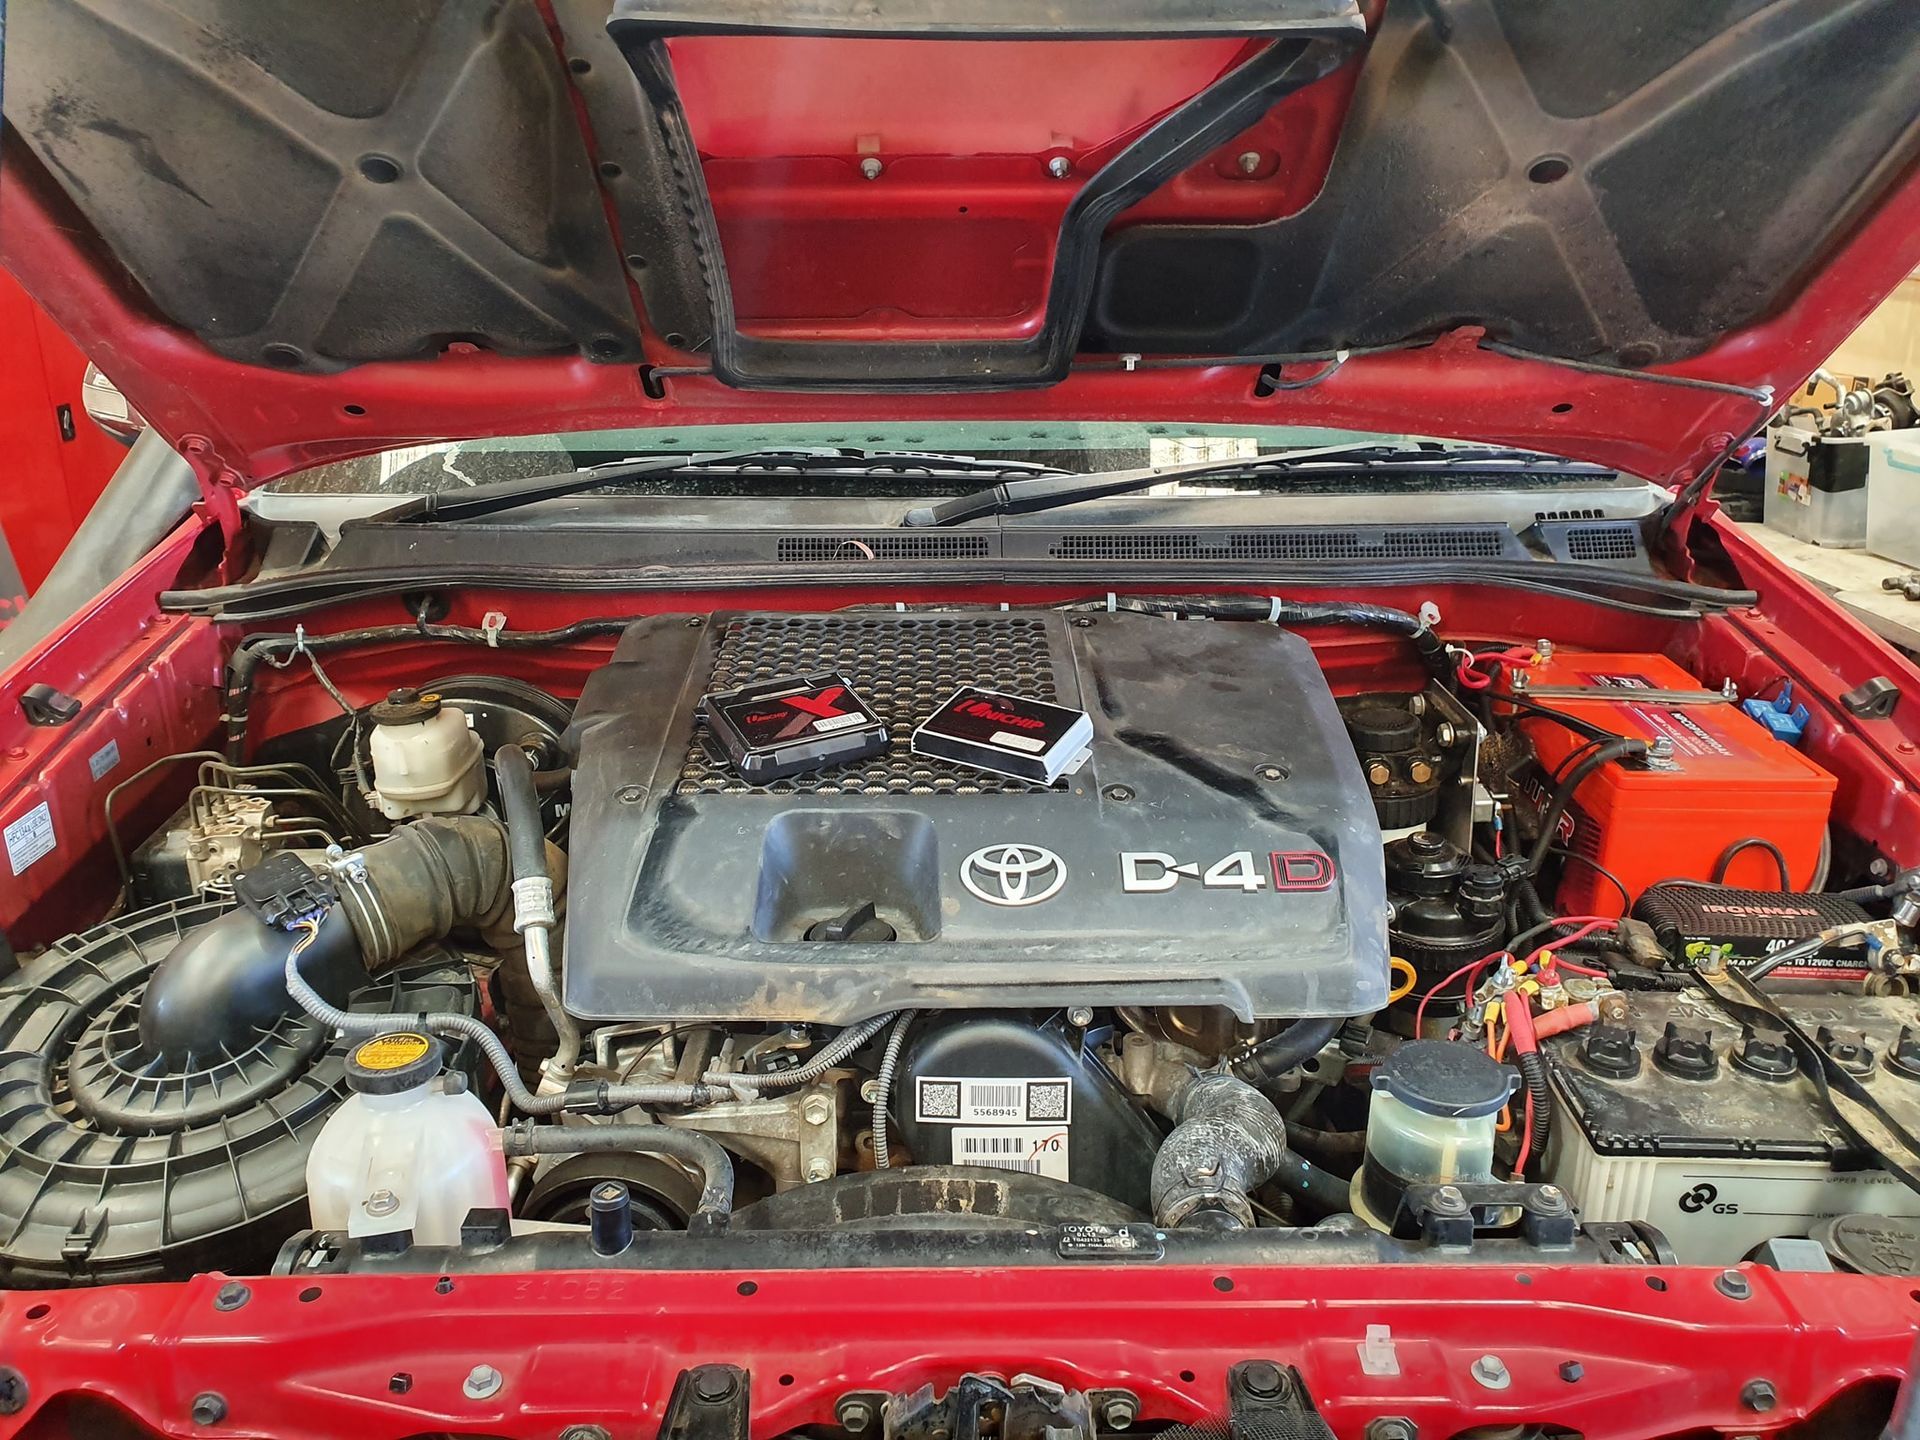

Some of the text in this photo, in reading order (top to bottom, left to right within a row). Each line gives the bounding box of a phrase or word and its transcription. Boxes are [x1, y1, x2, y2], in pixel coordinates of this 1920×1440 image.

[1701, 904, 1819, 917] IRONMAN
[1808, 959, 1834, 967] 12VDC
[974, 1109, 1018, 1117] 5568945
[1032, 1139, 1060, 1152] 170
[1863, 1177, 1894, 1185] LEVEL
[1713, 1203, 1738, 1214] GS
